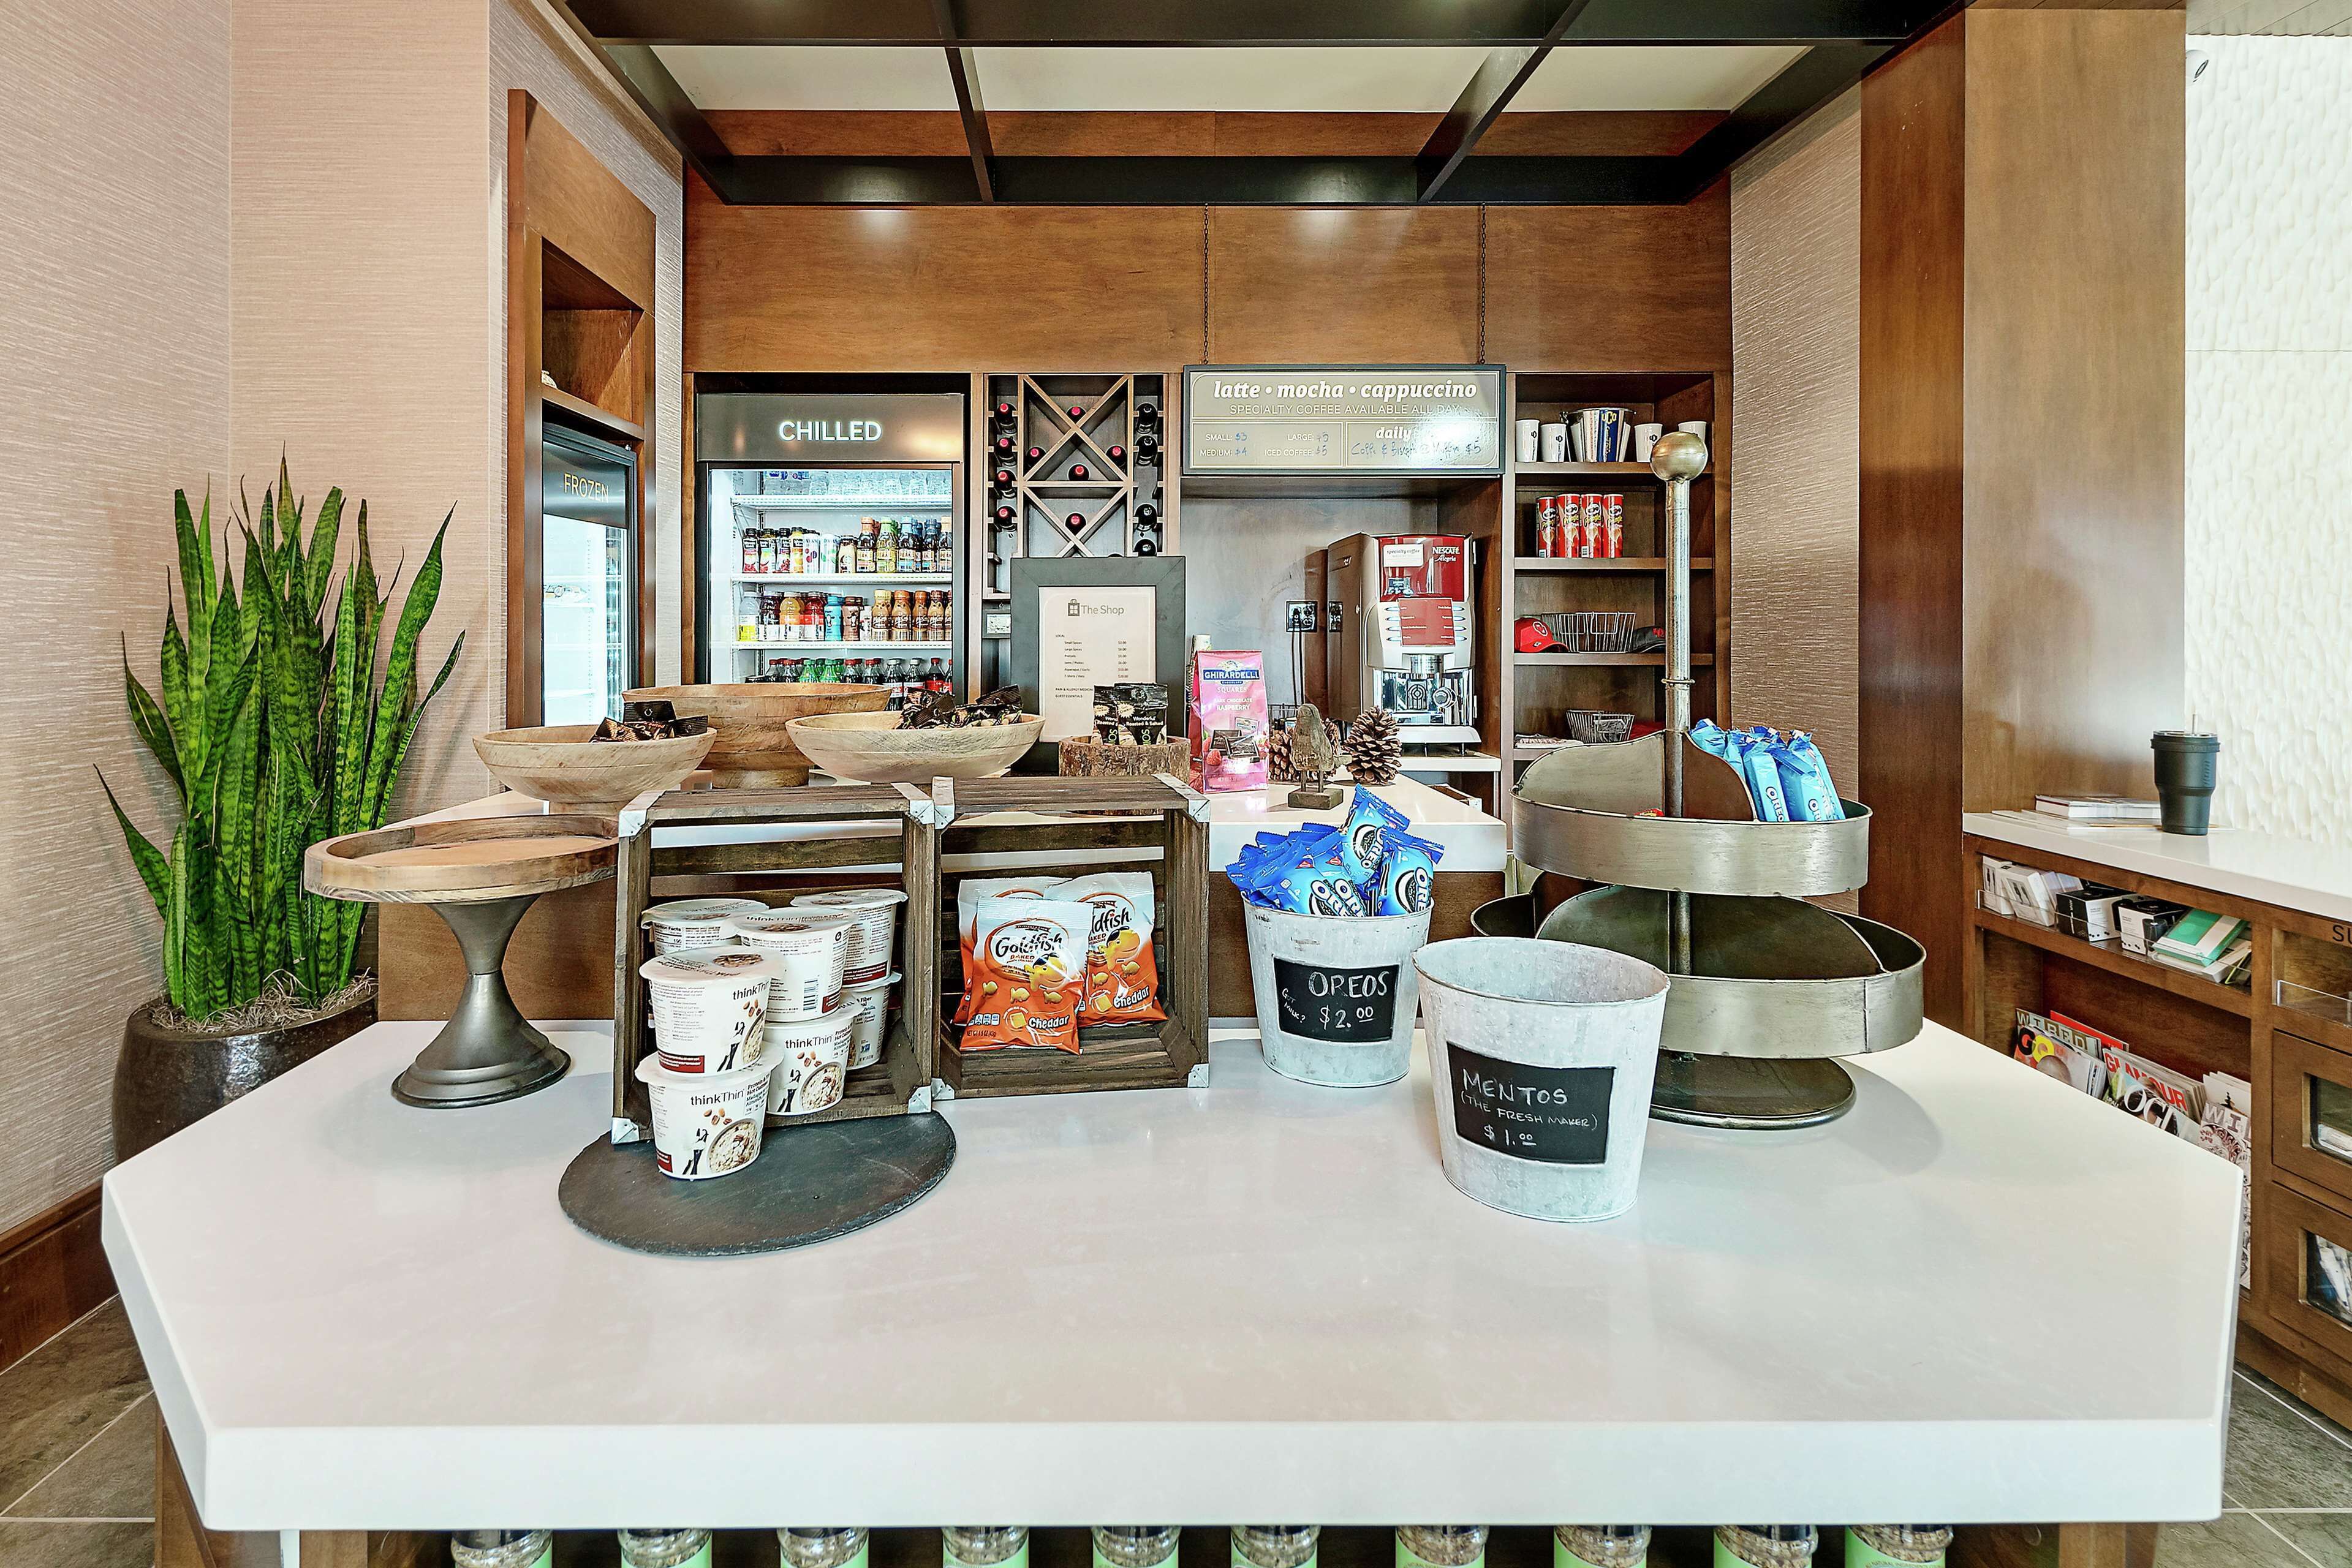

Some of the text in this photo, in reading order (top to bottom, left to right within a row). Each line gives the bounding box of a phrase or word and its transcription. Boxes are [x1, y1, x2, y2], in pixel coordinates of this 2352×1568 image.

[1214, 379, 1478, 402] latte mocha cappuccino
[1230, 405, 1293, 415] SPECIALTY
[1296, 405, 1340, 414] COFFEE
[1345, 405, 1408, 414] AVAILABLE
[1411, 405, 1432, 414] ALL
[779, 421, 882, 441] CHILLED
[1375, 426, 1412, 442] daily
[564, 473, 609, 503] FROZEN
[1081, 605, 1124, 616] The Shop
[1204, 671, 1259, 679] GHIRARDELLI
[995, 933, 1062, 957] Goldfish
[1309, 971, 1390, 998] OREOS
[1029, 1015, 1070, 1029] Cheddar
[785, 1035, 831, 1049] thinkThin
[2017, 1027, 2055, 1063] GQ
[1463, 1068, 1568, 1106] MENTOS
[690, 1090, 743, 1106] thinkThin
[1461, 1090, 1598, 1131] (THE FRESH MAKER)
